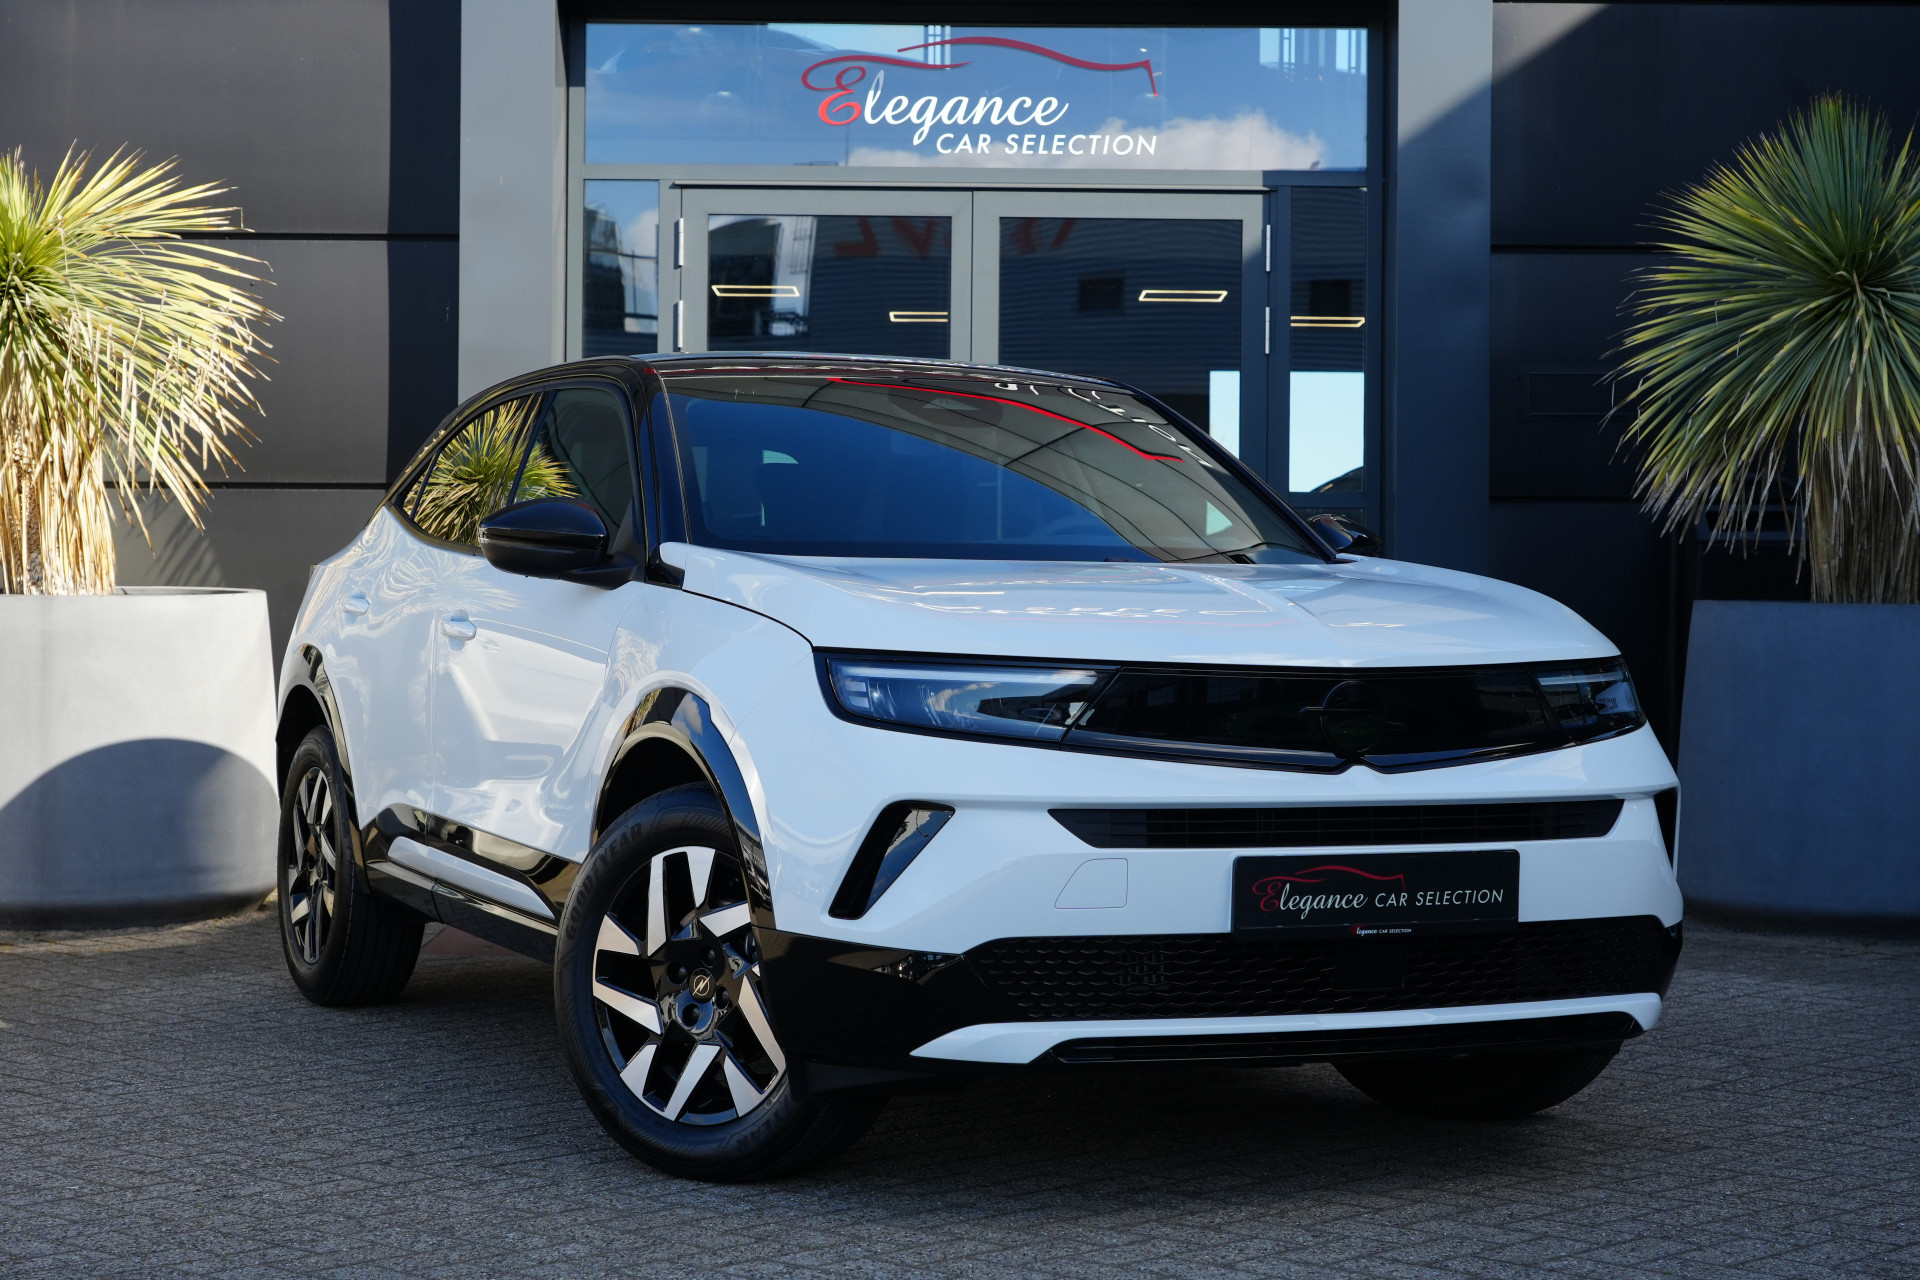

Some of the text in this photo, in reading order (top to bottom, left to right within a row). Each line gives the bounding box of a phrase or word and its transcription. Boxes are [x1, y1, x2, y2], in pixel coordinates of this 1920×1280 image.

[803, 58, 1069, 146] Elegance
[936, 133, 1158, 156] CAR SELECTION
[565, 822, 643, 941] GOODYEAR
[1253, 879, 1504, 920] Elegance CAR SELECTION
